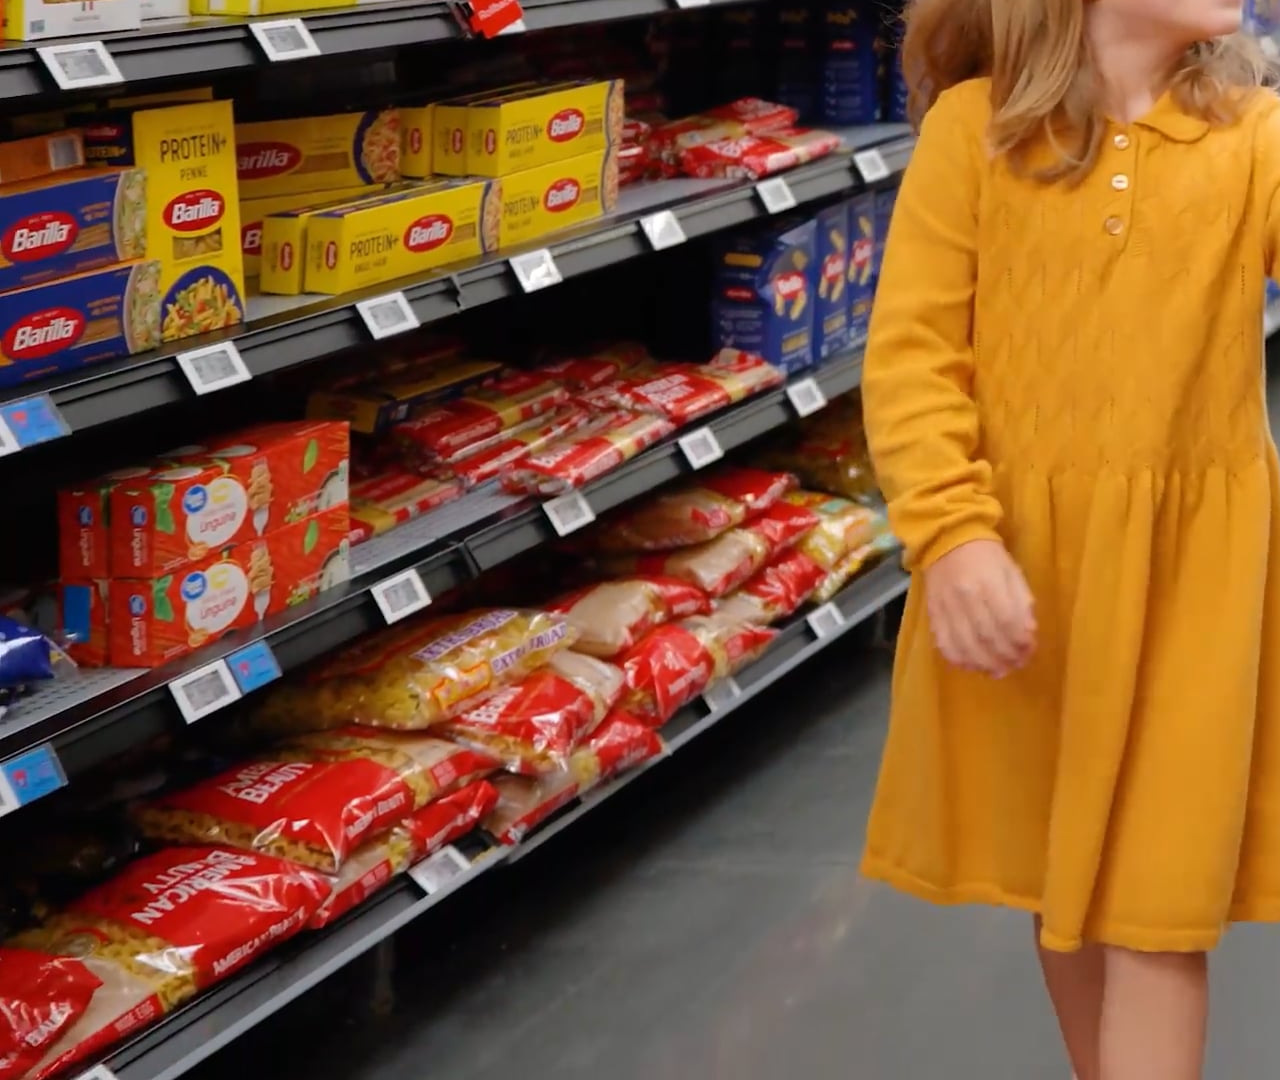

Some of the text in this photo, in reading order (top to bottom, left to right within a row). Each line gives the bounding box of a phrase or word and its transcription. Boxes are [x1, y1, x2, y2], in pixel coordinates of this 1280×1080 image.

[505, 124, 543, 144] PROTEIN+
[551, 114, 584, 137] Barilla
[159, 132, 227, 164] PROTEIN+
[180, 166, 208, 182] PENNE
[547, 184, 579, 207] Barilla
[172, 197, 222, 225] Barilla
[11, 221, 72, 253] Barilla
[350, 232, 399, 261] PROTEIN+
[409, 220, 449, 246] Barilla
[13, 316, 78, 351] Barilla
